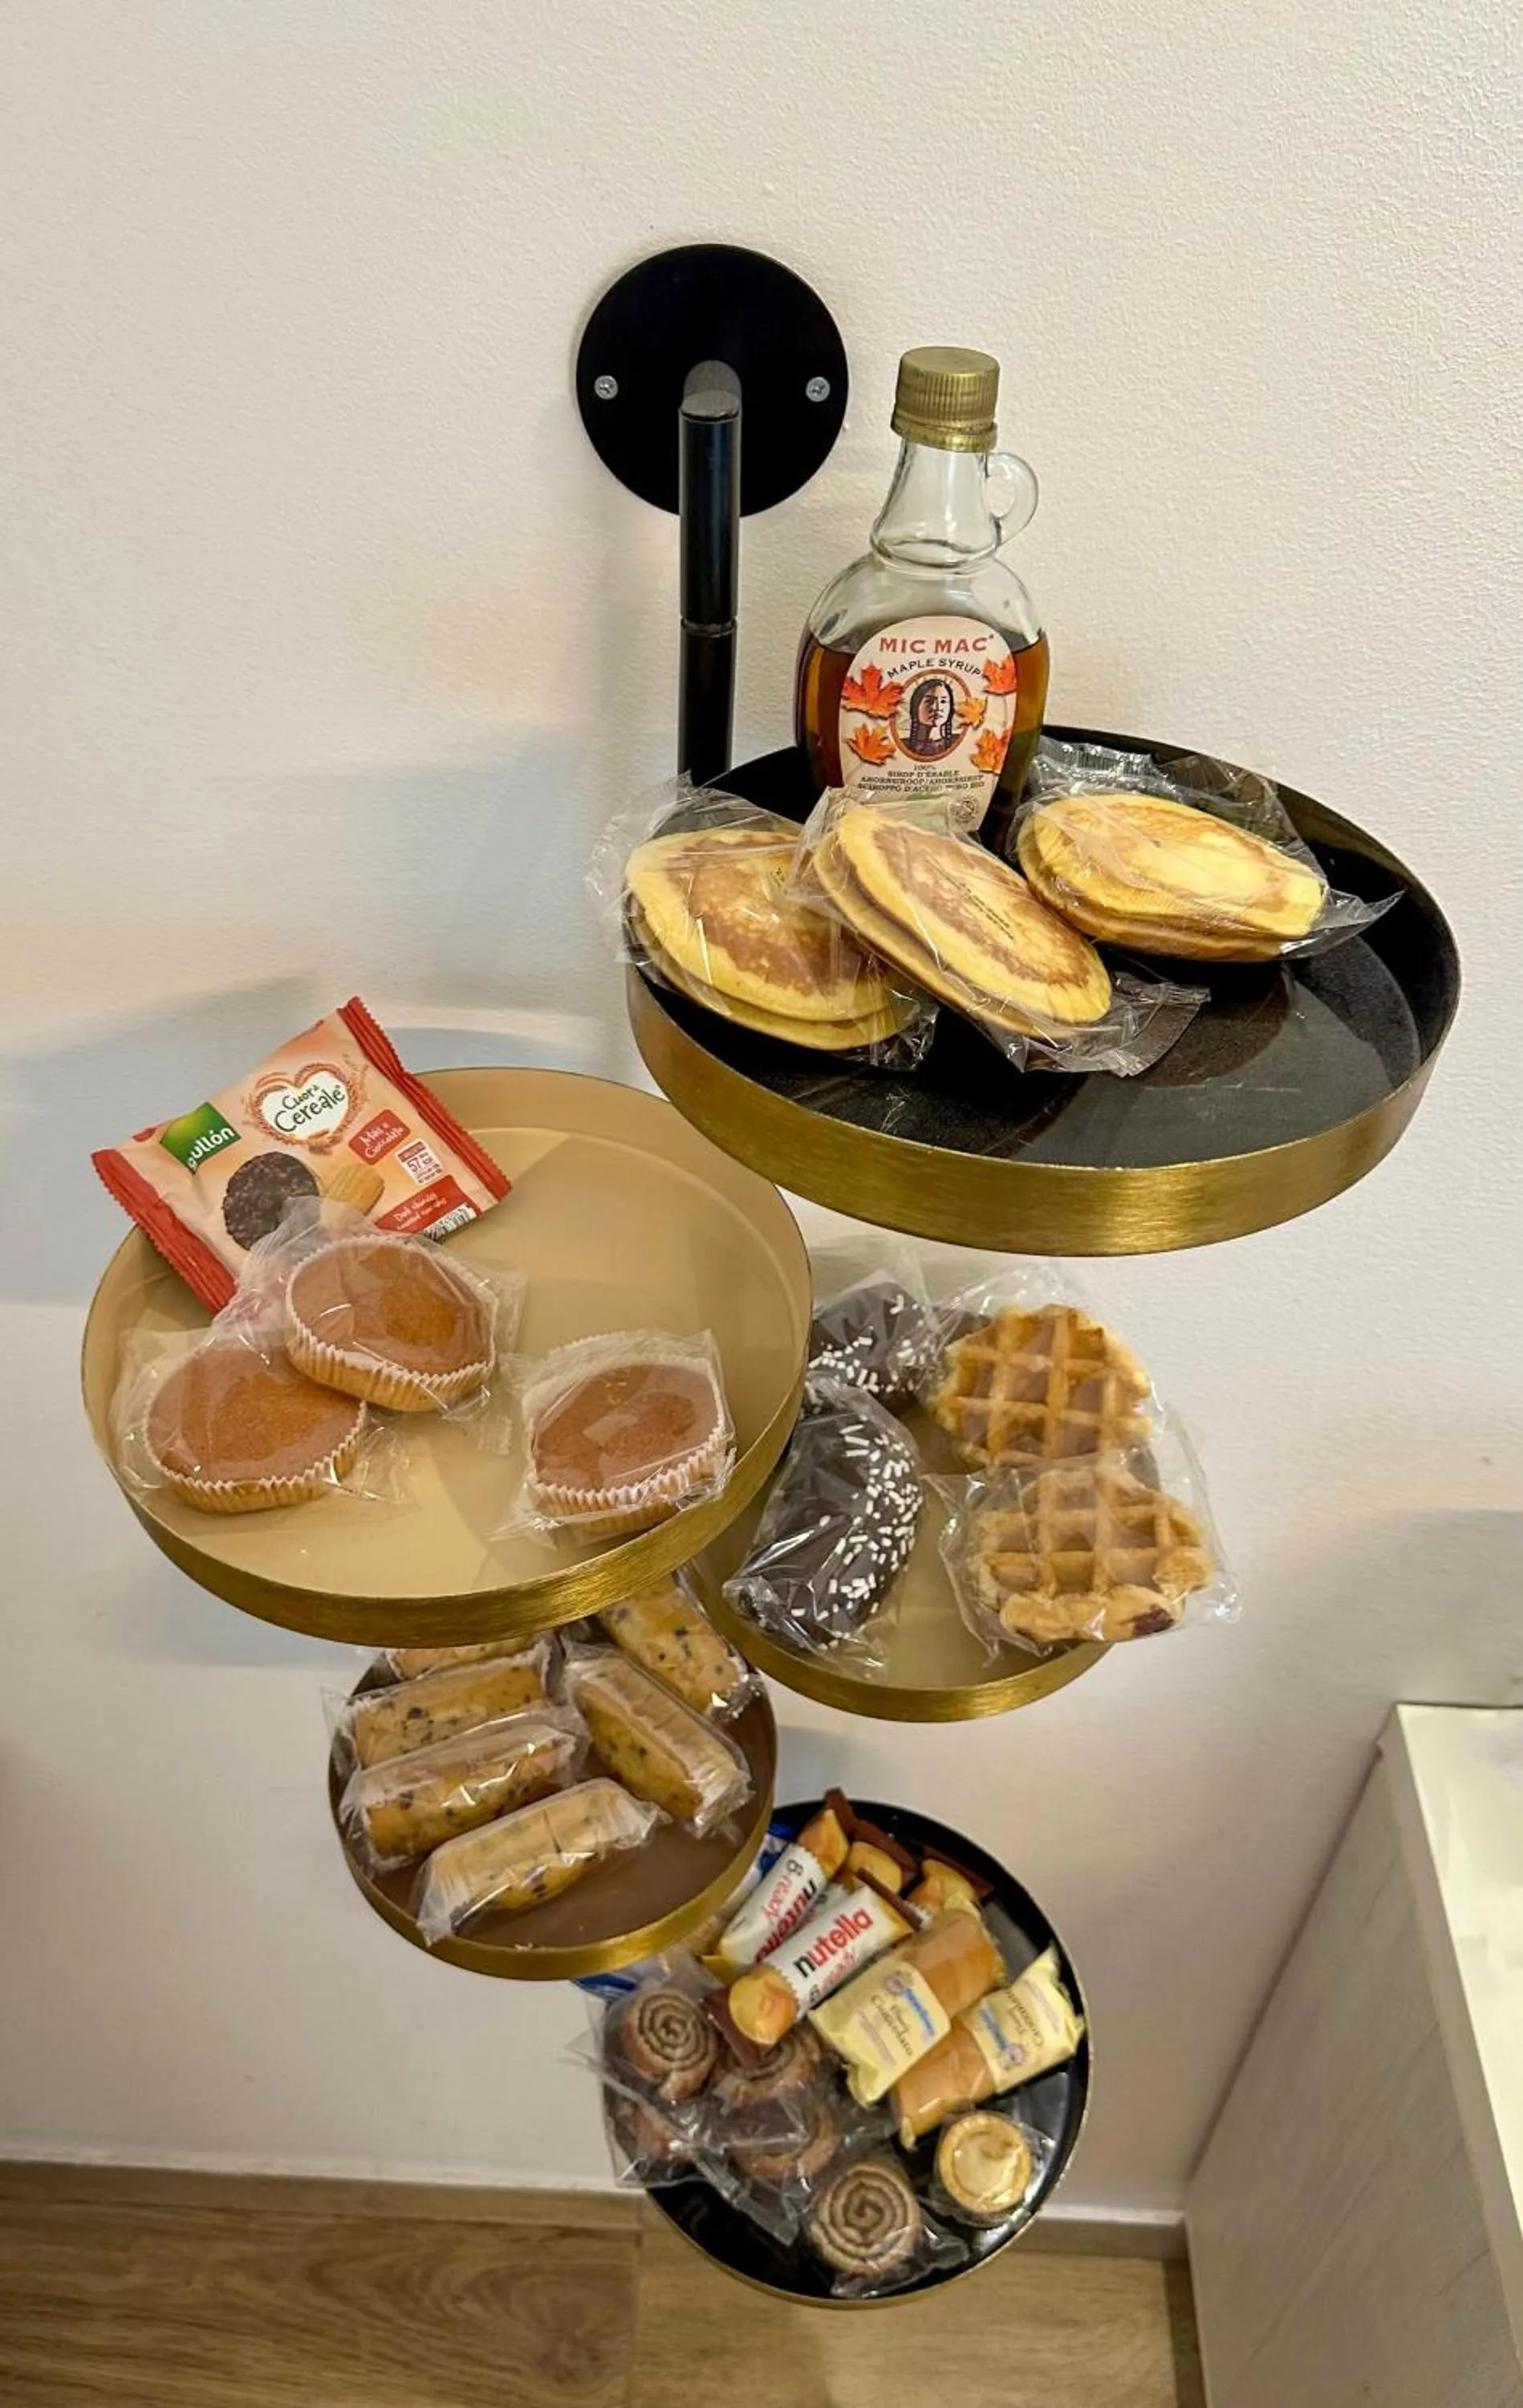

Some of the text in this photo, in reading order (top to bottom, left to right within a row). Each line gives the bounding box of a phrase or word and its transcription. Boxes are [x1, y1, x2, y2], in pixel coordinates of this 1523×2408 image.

[879, 636, 987, 654] MIC MAC
[887, 657, 981, 679] MAPLE SYRUP
[282, 1088, 315, 1110] Cuor
[274, 1088, 346, 1133] Cereale
[188, 1127, 236, 1171] gullón
[407, 1157, 421, 1172] 57
[794, 1907, 874, 1978] nutella
